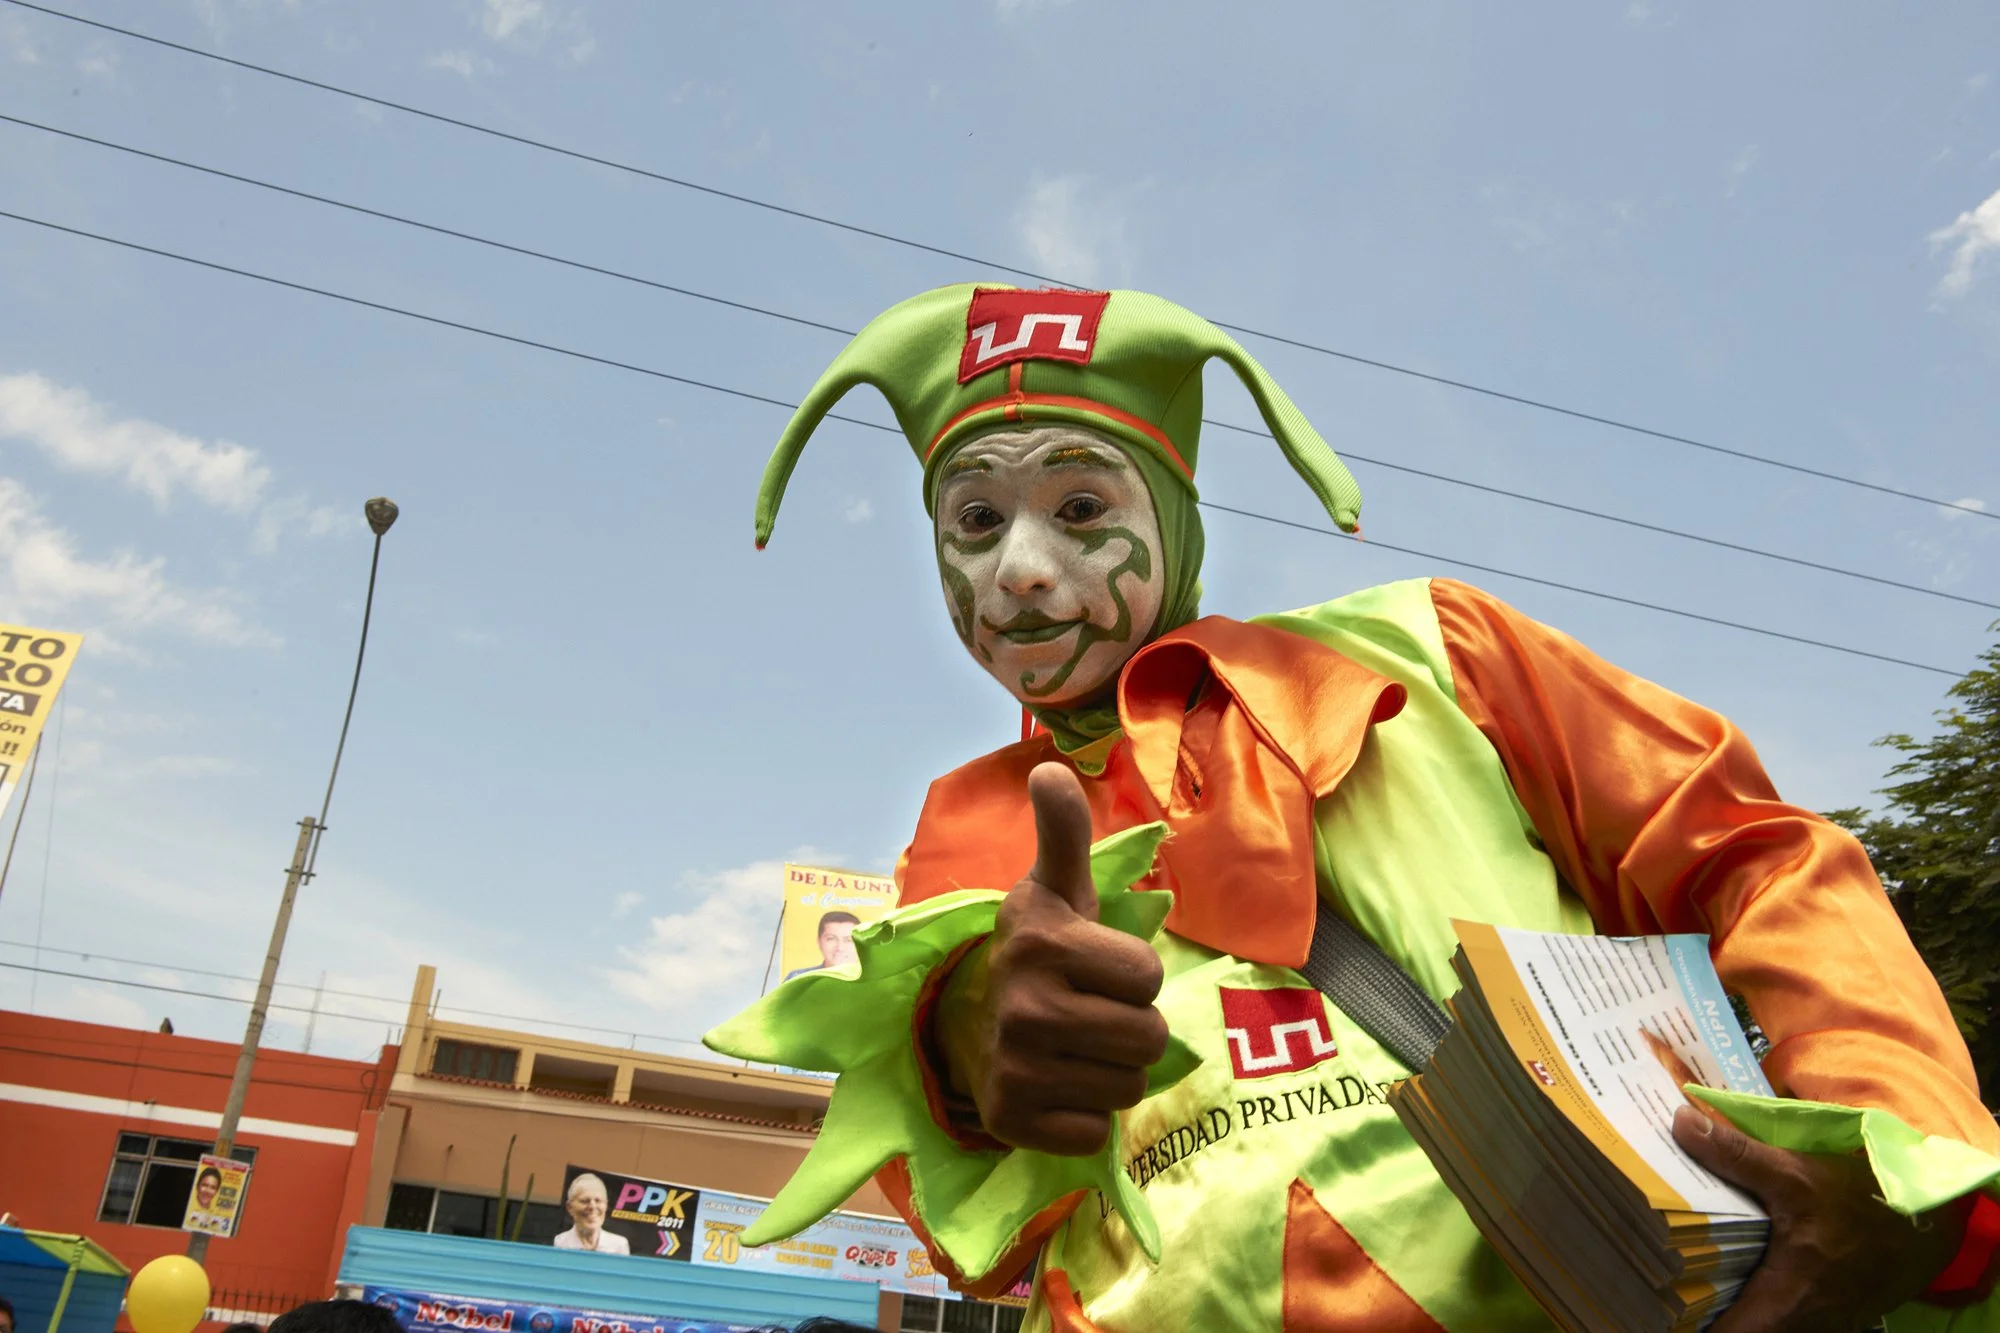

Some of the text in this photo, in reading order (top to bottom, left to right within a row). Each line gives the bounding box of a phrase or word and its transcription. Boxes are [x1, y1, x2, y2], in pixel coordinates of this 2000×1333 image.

[790, 870, 894, 894] DE LA UNT
[1526, 961, 1569, 1040] INGRESANTES
[1702, 999, 1733, 1048] UPN
[1566, 1042, 1580, 1060] DE
[1579, 1061, 1603, 1096] LISTA
[1098, 1075, 1387, 1219] UVERSIDAD PRIVADA
[614, 1182, 694, 1219] PPK
[657, 1215, 685, 1230] 2011
[703, 1229, 739, 1264] 20
[414, 1301, 515, 1332] Nobel
